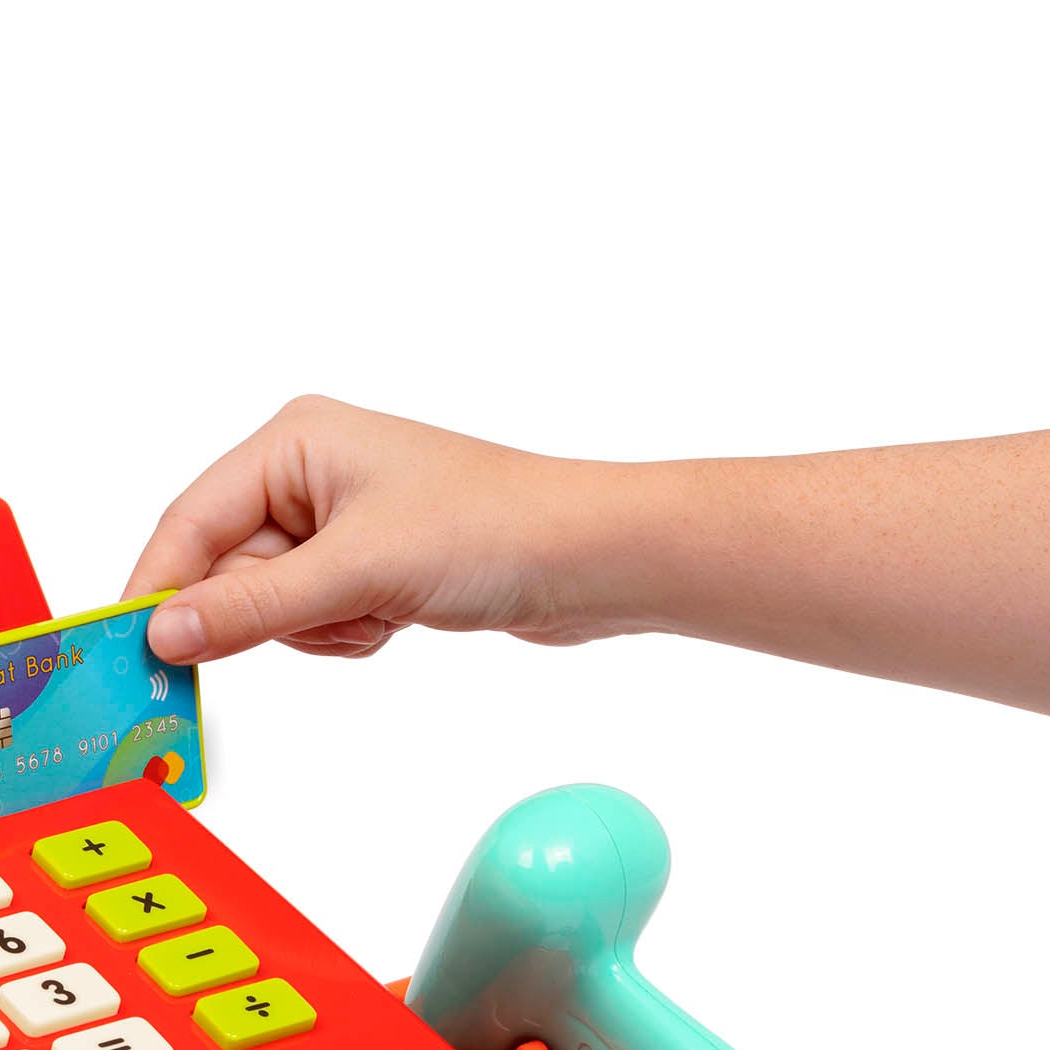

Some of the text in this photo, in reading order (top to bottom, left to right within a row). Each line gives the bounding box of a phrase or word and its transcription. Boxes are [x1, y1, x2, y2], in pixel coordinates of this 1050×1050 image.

[26, 644, 86, 680] Bank
[15, 746, 64, 775] 5678
[78, 731, 120, 757] 9101
[132, 714, 180, 743] 2345
[41, 979, 77, 1006] 3
